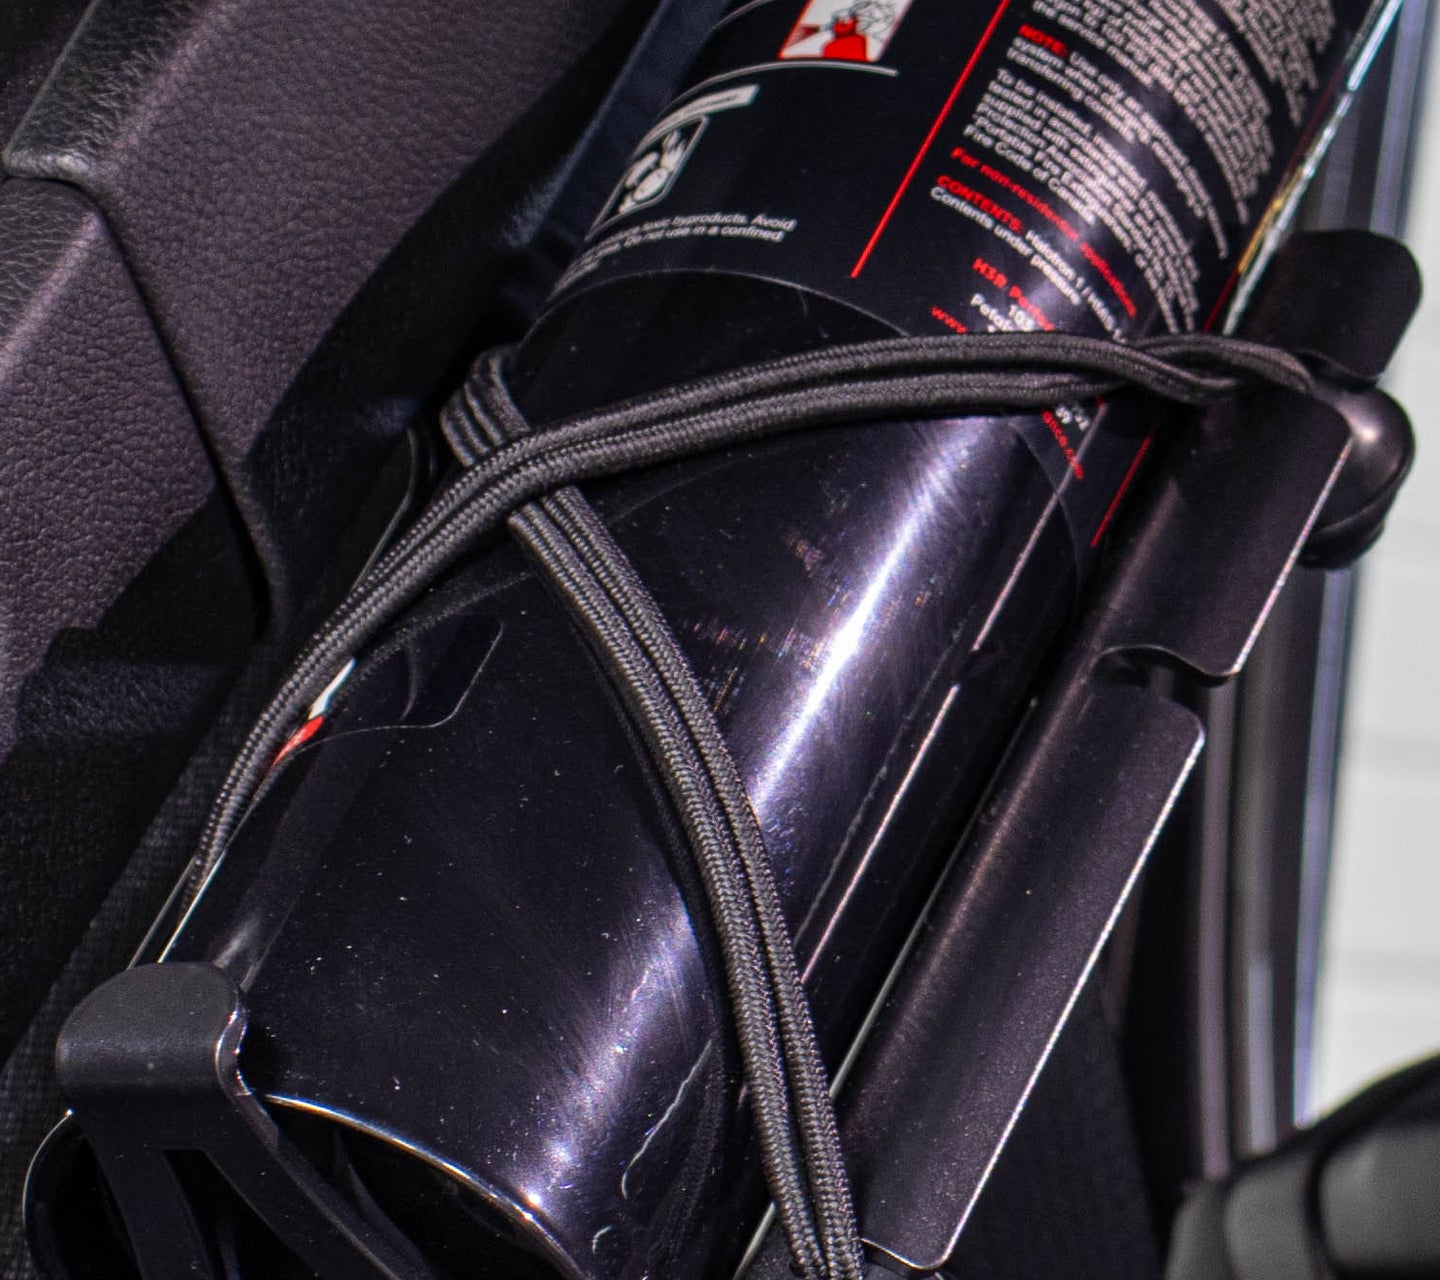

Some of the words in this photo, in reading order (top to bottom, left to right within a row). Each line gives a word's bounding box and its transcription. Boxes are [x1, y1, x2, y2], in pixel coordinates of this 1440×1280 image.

[1033, 0, 1057, 17] the
[1058, 14, 1106, 48] service
[1083, 12, 1098, 27] to
[1102, 23, 1125, 46] 100
[1122, 25, 1172, 70] Halotron
[1007, 47, 1085, 100] transferring
[1014, 37, 1064, 69] system
[1064, 67, 1100, 94] when
[997, 68, 1015, 85] To
[1014, 79, 1035, 96] be
[1036, 93, 1093, 138] installed,
[1019, 25, 1063, 54] NOTE:
[1070, 52, 1098, 76] Use
[1098, 74, 1125, 101] only
[1124, 97, 1141, 114] an
[1139, 112, 1187, 166] approved
[964, 125, 993, 146] Fire
[995, 141, 1033, 170] Code
[1032, 167, 1050, 181] of
[976, 103, 1046, 148] Protection
[1046, 145, 1113, 207] Association
[982, 94, 1043, 131] supplied
[1042, 128, 1070, 150] with
[1070, 148, 1135, 212] extinguisher
[988, 81, 1034, 110] tested
[1033, 106, 1048, 119] in
[1049, 119, 1120, 178] accordance
[1117, 174, 1139, 199] with
[1034, 151, 1061, 175] Fire
[751, 212, 798, 232] Avoid
[951, 147, 979, 167] For
[980, 165, 1080, 244] non-residential
[665, 224, 691, 239] use
[692, 223, 707, 236] in
[720, 224, 786, 244] confined
[931, 187, 994, 229] Contents
[994, 225, 1033, 256] under
[1030, 254, 1080, 305] pressure
[937, 176, 1021, 231] CONTENTS:
[1026, 231, 1074, 280] Halotron
[973, 258, 1007, 288] H3R
